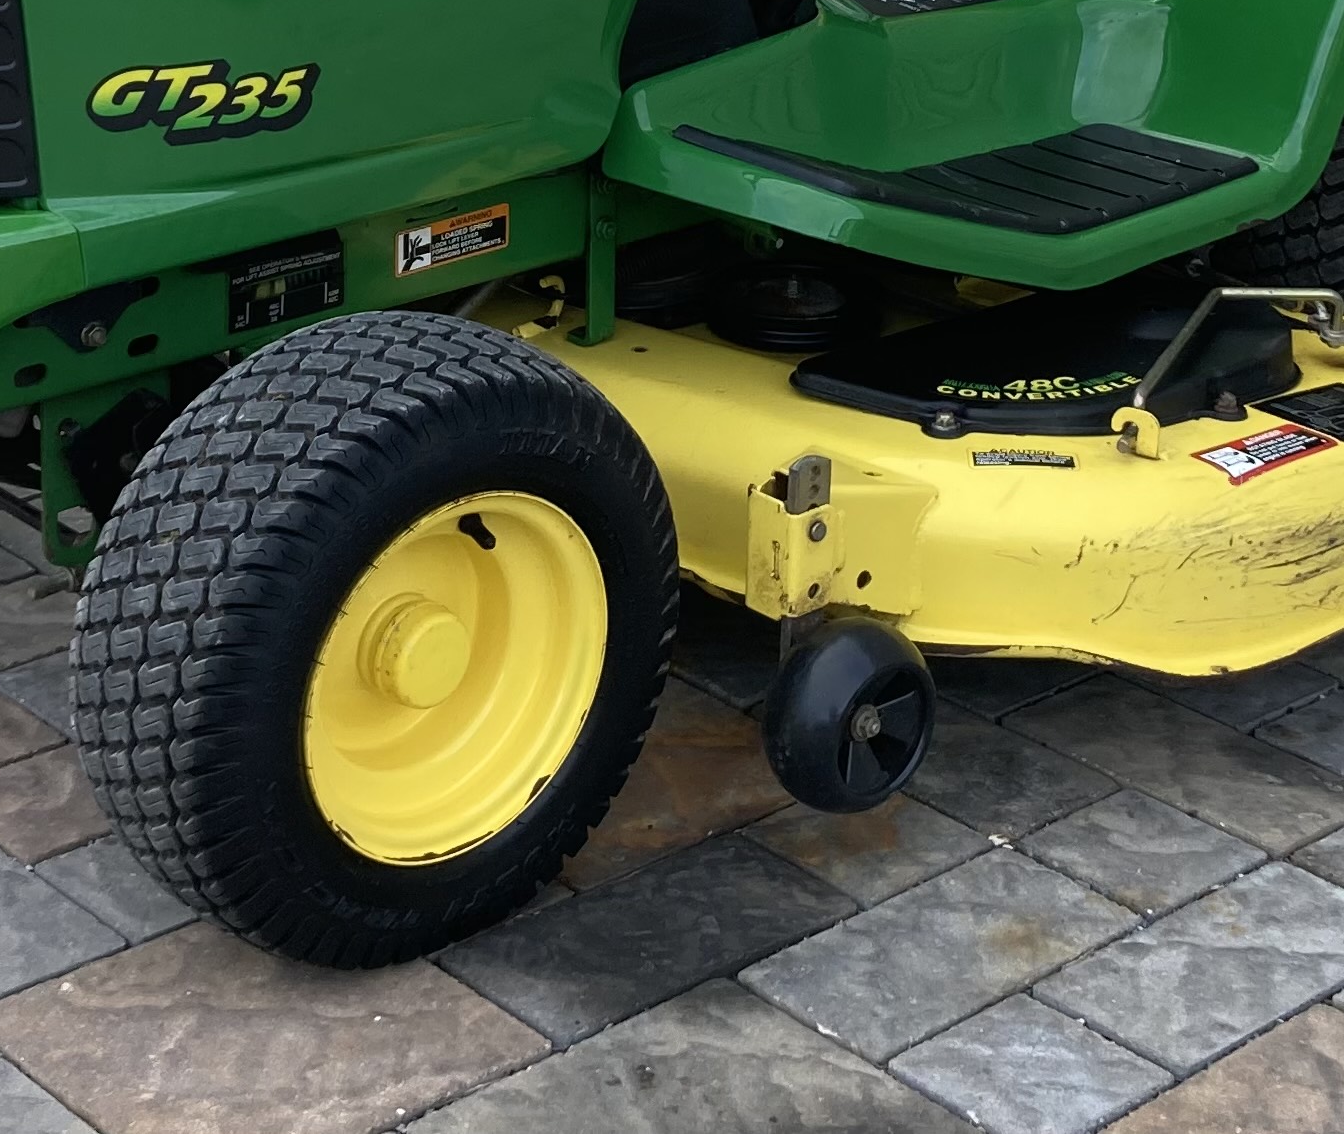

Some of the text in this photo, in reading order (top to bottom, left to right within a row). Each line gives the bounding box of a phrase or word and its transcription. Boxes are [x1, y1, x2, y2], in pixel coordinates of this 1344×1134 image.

[441, 227, 468, 240] LOADED
[936, 374, 1143, 401] CONVERTIBLE
[1004, 376, 1080, 393] 48C
